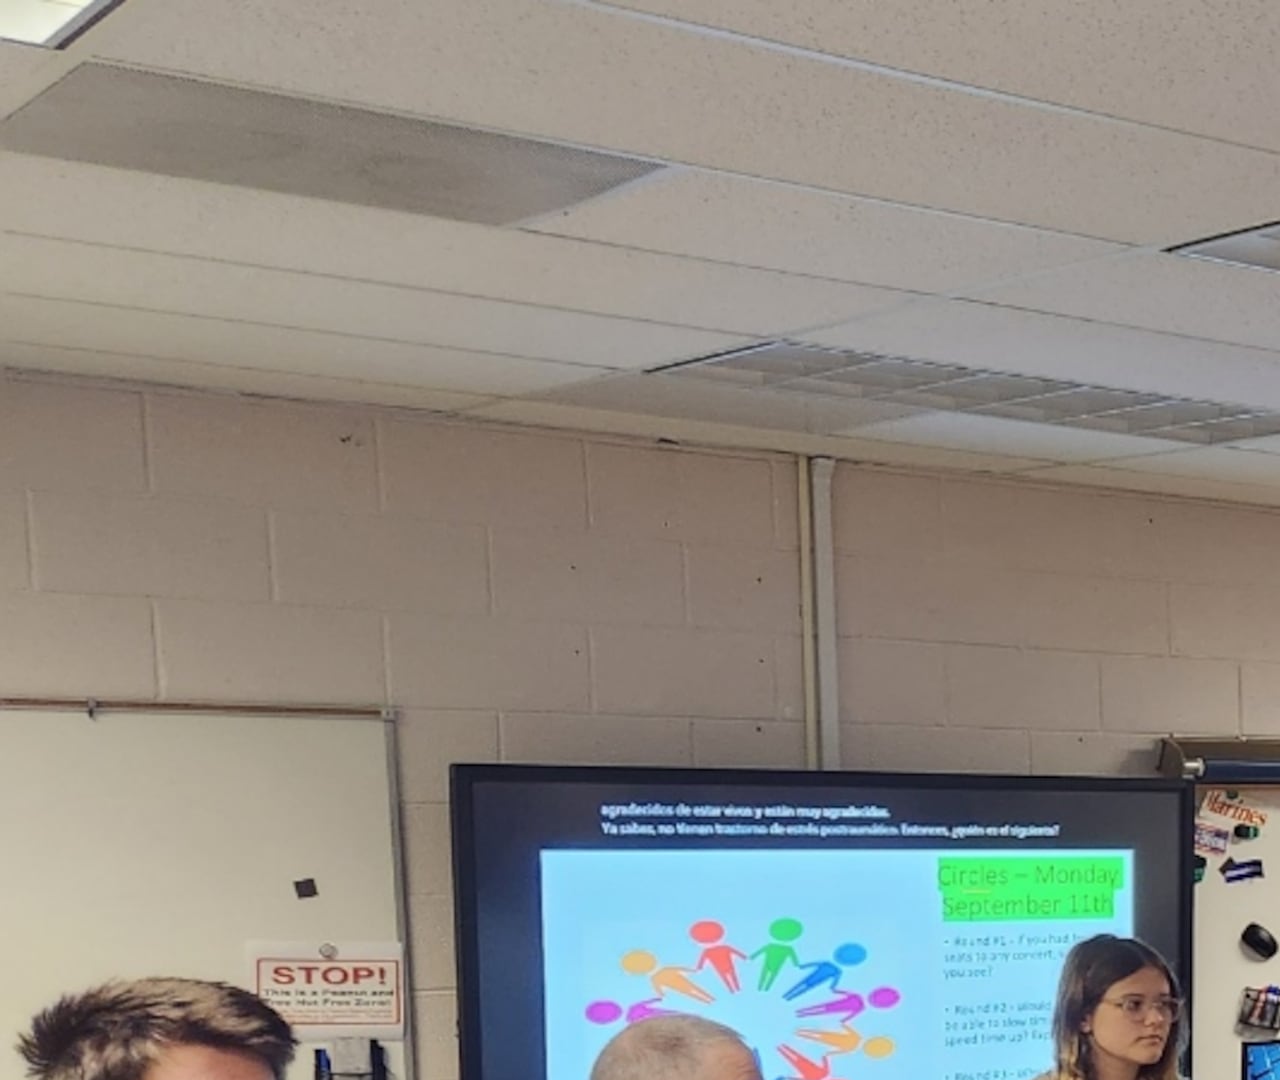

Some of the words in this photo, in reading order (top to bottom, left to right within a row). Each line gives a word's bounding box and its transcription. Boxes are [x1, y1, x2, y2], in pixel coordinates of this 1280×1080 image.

[601, 803, 674, 818] agradecidos
[676, 804, 691, 816] de
[601, 822, 618, 834] Ya
[938, 864, 1009, 887] Circles
[1036, 864, 1121, 889] Monday
[943, 893, 1060, 920] September
[1070, 893, 1115, 916] 11th
[272, 966, 386, 985] STOP!
